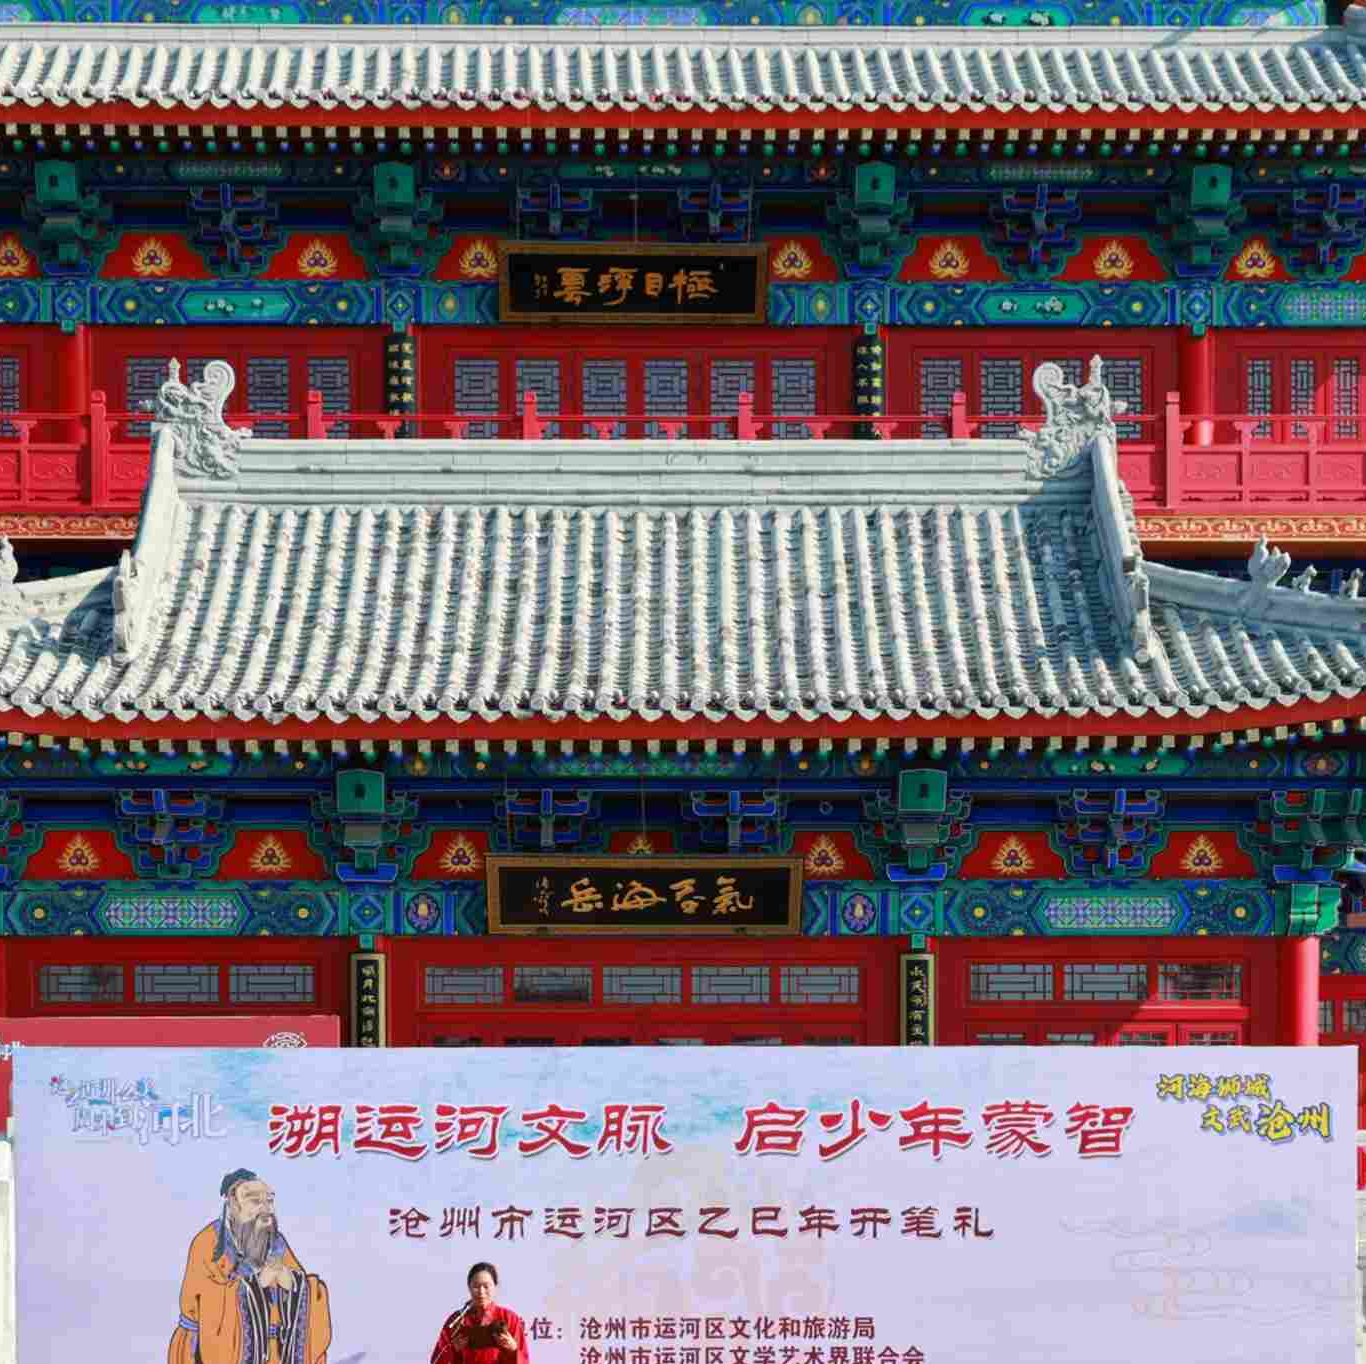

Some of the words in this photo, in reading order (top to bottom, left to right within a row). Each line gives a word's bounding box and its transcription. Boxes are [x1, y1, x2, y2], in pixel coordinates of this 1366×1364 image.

[1156, 1073, 1271, 1102] 河海狮城
[267, 1102, 670, 1160] 溯运河文脉
[736, 1099, 1134, 1159] 启少年蒙智
[1200, 1100, 1332, 1143] 文武沧州
[389, 1205, 995, 1240] 沧州市运河区乙巳年开笔礼
